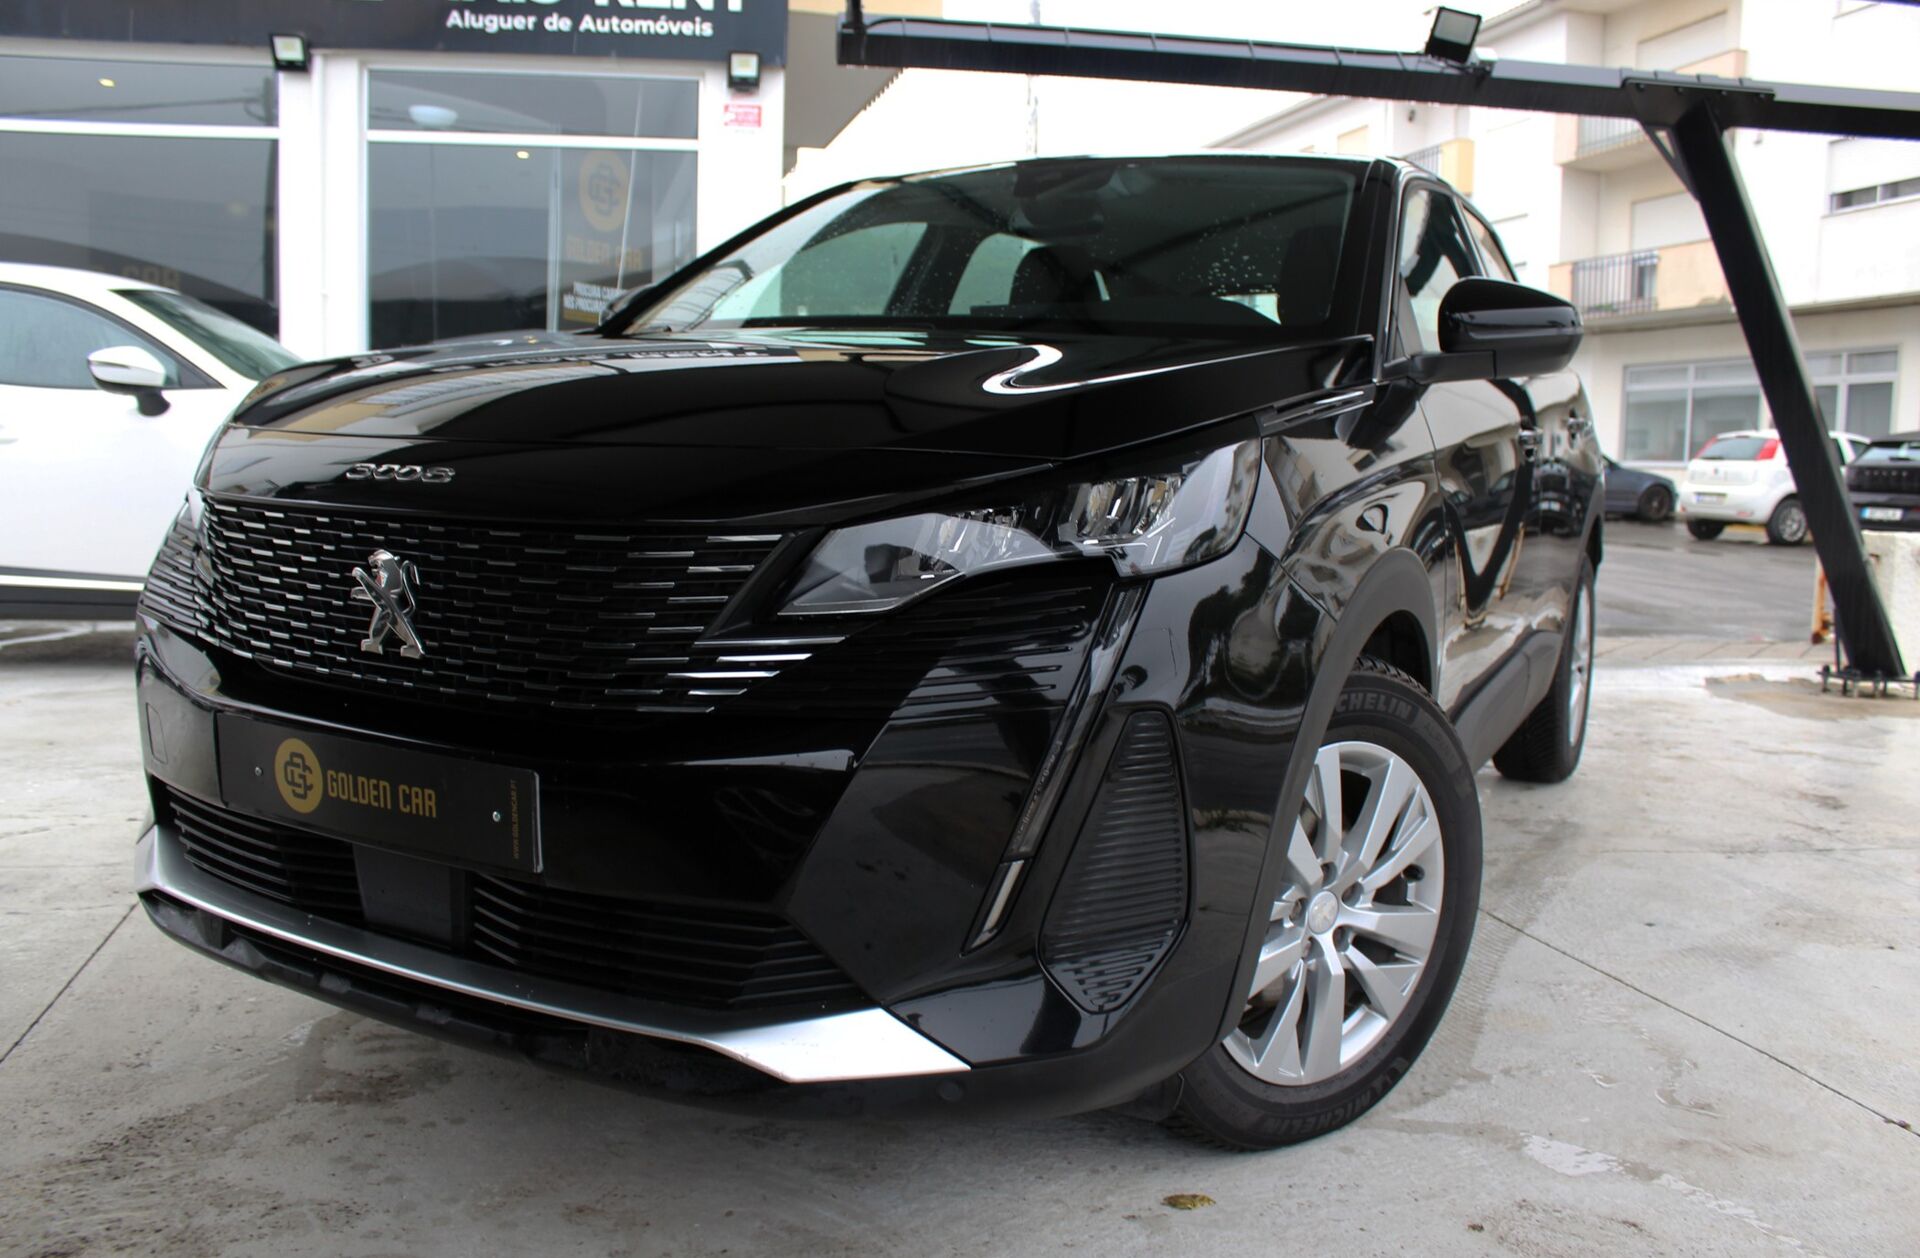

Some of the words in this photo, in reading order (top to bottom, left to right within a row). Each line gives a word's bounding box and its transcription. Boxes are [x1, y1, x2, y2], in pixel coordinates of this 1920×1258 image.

[446, 9, 536, 33] Aluguer
[543, 12, 572, 32] de
[579, 14, 713, 37] Automóveis
[346, 463, 455, 482] 3008
[1336, 692, 1412, 719] CHELIN
[327, 769, 391, 809] GOLDEN
[399, 784, 436, 818] CAR
